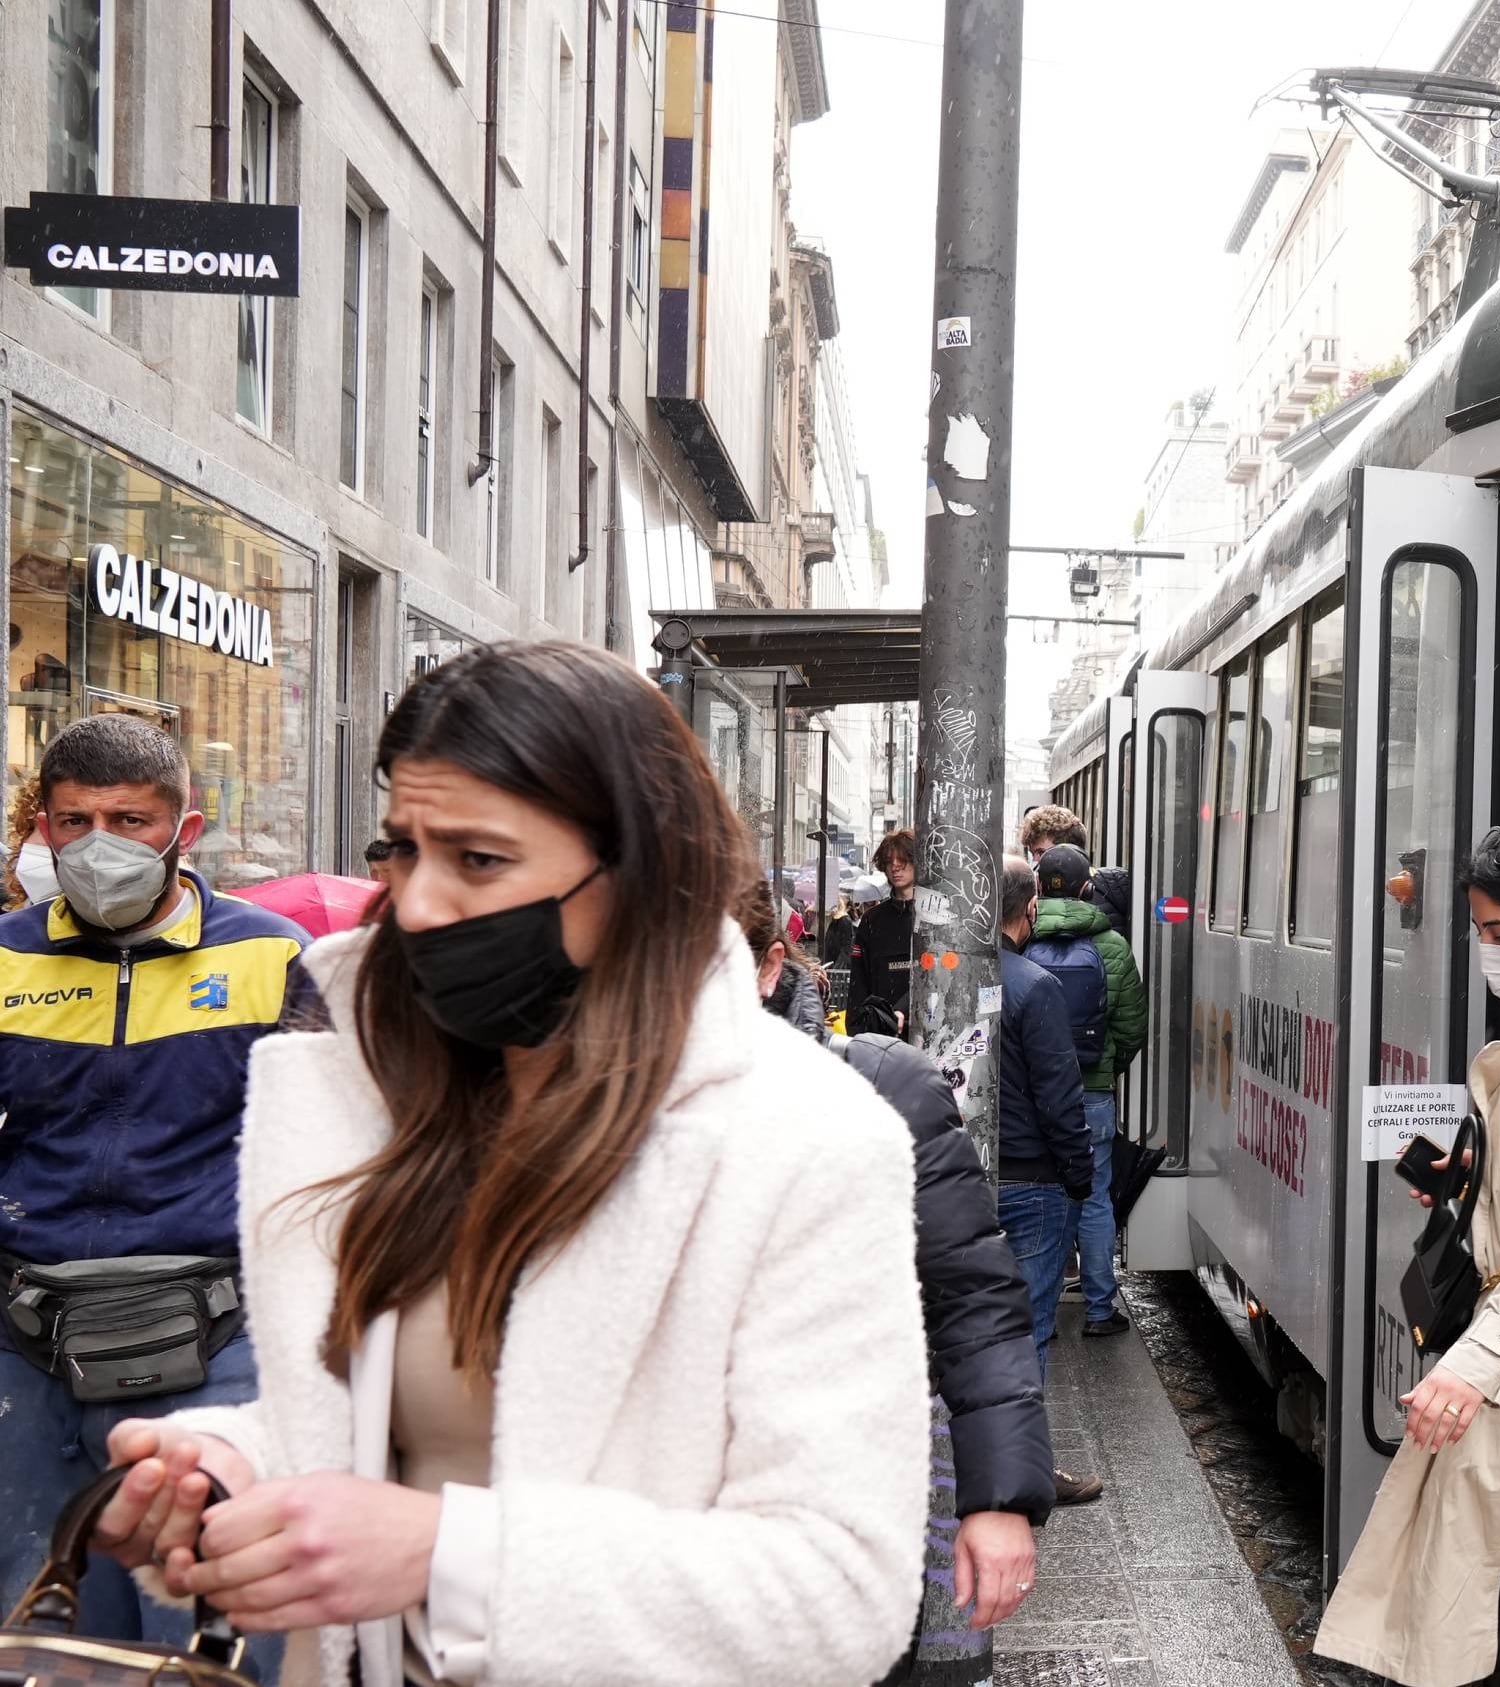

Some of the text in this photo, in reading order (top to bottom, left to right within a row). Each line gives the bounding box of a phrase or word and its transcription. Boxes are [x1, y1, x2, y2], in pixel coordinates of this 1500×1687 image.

[47, 243, 280, 280] CALZEDONIA
[90, 543, 275, 668] CALZEDONIA
[4, 986, 93, 1009] GIVOVA
[1239, 992, 1260, 1071] NON
[1261, 1000, 1279, 1082] SAI
[1281, 990, 1302, 1094] PIÙ
[1304, 1014, 1335, 1112] DOV
[1384, 1091, 1393, 1099] Vi
[1395, 1090, 1434, 1099] invitiamo
[1417, 1103, 1426, 1112] LE
[1429, 1103, 1456, 1112] PORTE
[1405, 1117, 1410, 1126] E
[1237, 1075, 1307, 1198] LE TUE COSE?
[1398, 1130, 1426, 1140] Gra
